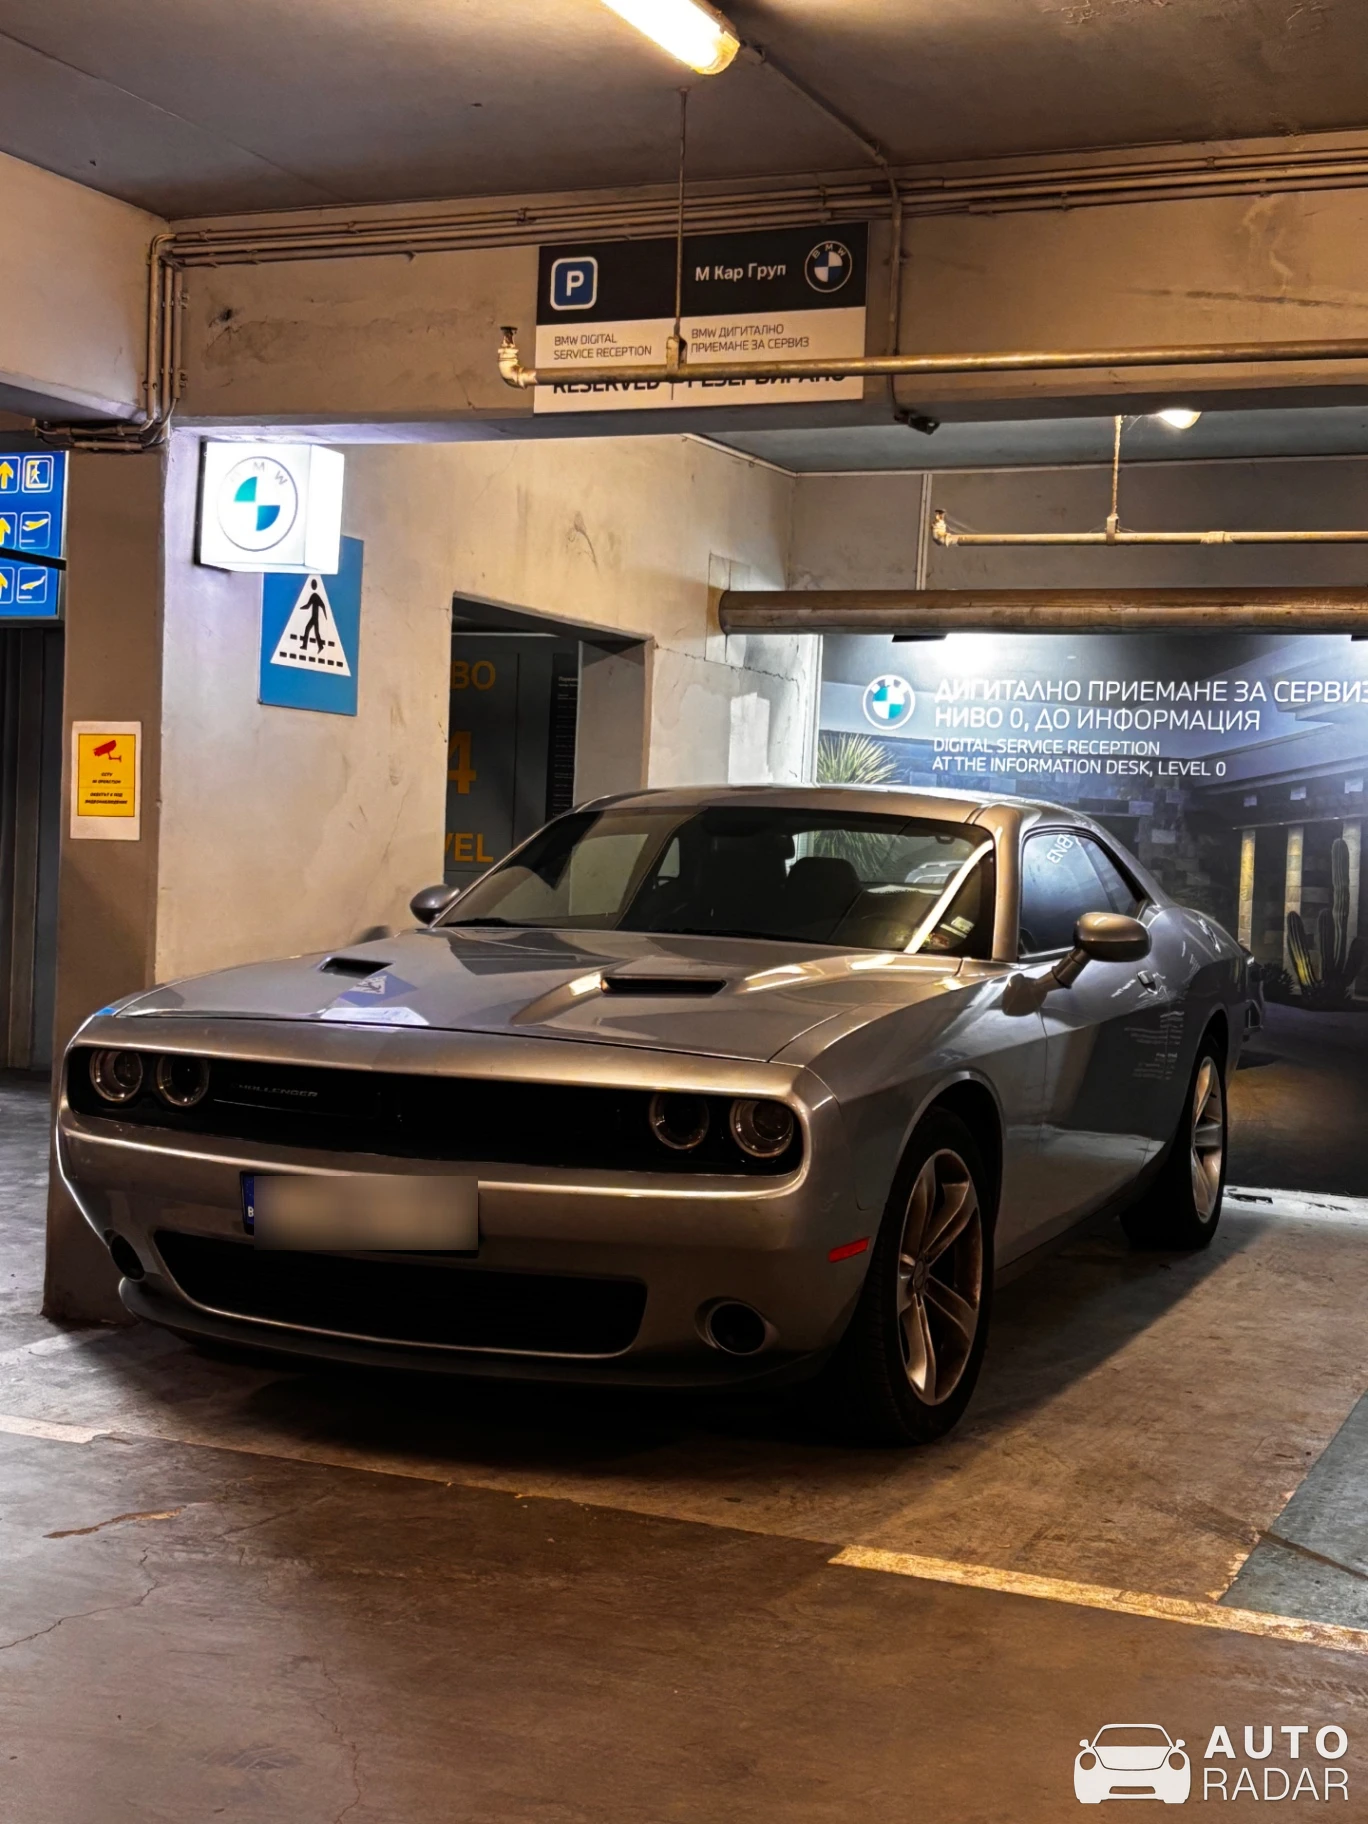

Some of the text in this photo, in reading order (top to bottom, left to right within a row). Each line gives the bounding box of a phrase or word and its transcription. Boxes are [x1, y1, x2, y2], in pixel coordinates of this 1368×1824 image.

[811, 243, 846, 259] BMW
[695, 262, 786, 282] М Кар Груп
[566, 270, 584, 296] P
[554, 333, 617, 346] BMW DIGITAL
[691, 323, 784, 339] BMW ДИГИТАЛНО
[553, 345, 653, 360] SERVICE RECEPTION
[690, 336, 809, 353] ПРИЕМАНЕ ЗА СЕРВИЗ
[935, 679, 1081, 703] ДИГИТАЛНО
[1089, 680, 1228, 702] ПРИЕМАНЕ
[1234, 681, 1267, 702] ЗА
[935, 706, 1261, 734] НИВО 0, ДО ИНФОРМАЦИЯ
[933, 737, 1160, 756] DIGITAL SERVICE RECEPTION
[932, 756, 1226, 778] AT THE INFORMATION DESK, LEVEL 0
